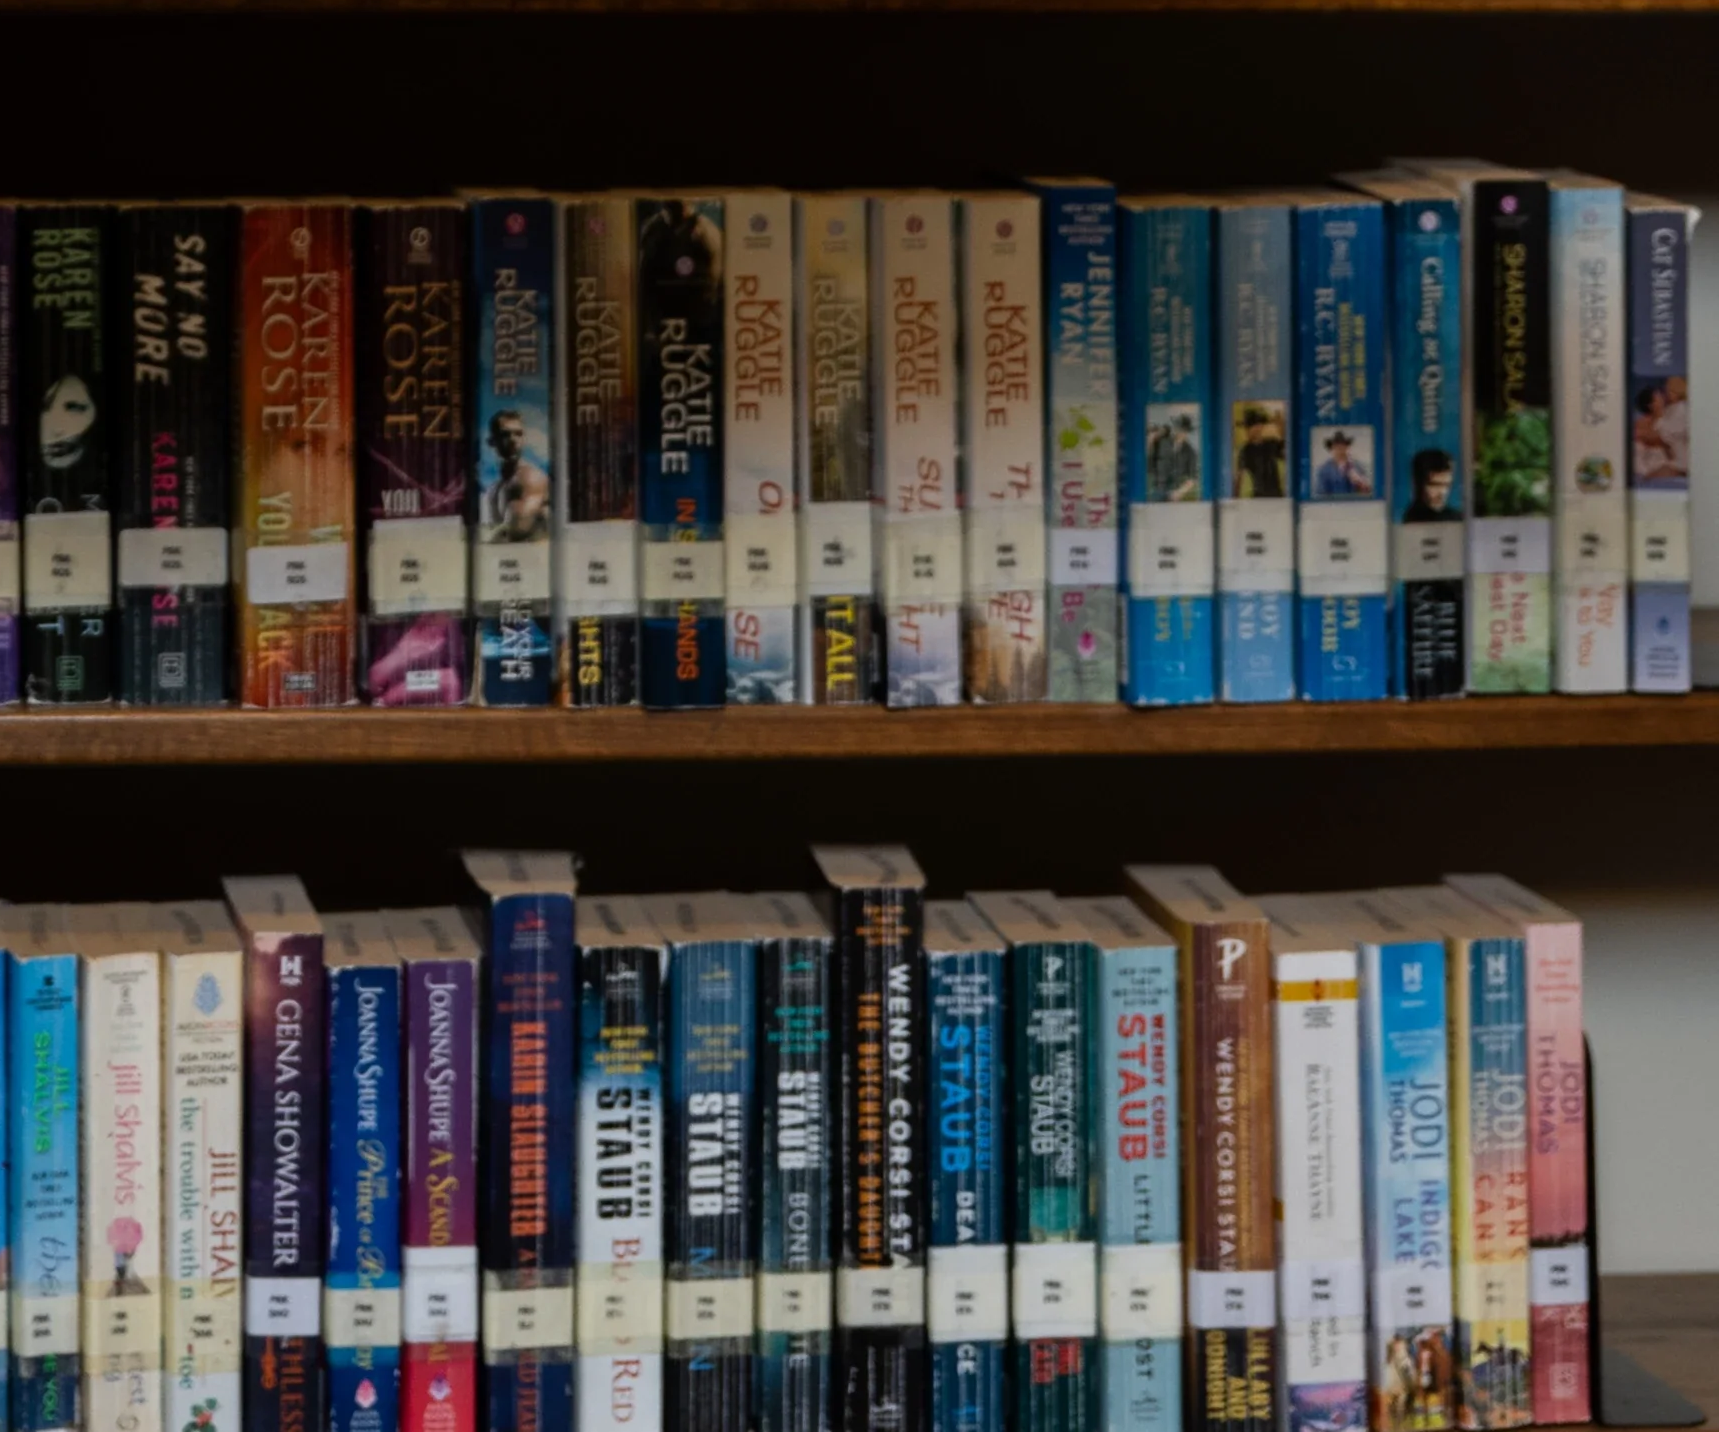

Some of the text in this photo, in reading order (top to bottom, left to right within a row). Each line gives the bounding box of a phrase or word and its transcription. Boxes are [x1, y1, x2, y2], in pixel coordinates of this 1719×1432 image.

[33, 229, 62, 309] ROSE
[64, 228, 92, 330] KAREN
[135, 274, 168, 385] MORE
[175, 236, 208, 359] SAY NO
[1059, 283, 1083, 365] RYAN
[1086, 252, 1112, 398] JENNIFER
[1504, 245, 1526, 414] SHARON SALA
[261, 275, 297, 431] ROSE
[301, 271, 329, 430] KAREN
[383, 286, 418, 439] ROSE
[419, 282, 450, 437] KAREN
[492, 269, 517, 395] RUGGLE
[516, 290, 538, 375] KATIE
[574, 276, 600, 426] RUGGLE
[599, 301, 623, 399] KATIE
[734, 275, 758, 422] RUGGLE
[757, 300, 782, 397] KATIE
[812, 276, 837, 427] RUGGLE
[837, 303, 862, 400] KATIE
[894, 277, 917, 425] RUGGLE
[915, 301, 938, 398] KATIE
[984, 282, 1007, 428] RUGGLE
[1005, 306, 1028, 403] KATIE
[1314, 346, 1336, 419] RYAN
[1587, 257, 1608, 425] SHARON SALA
[660, 318, 687, 474] RUGGLE
[684, 343, 713, 447] KATIE
[827, 639, 856, 689] ALL
[1484, 618, 1507, 662] Day
[34, 1031, 51, 1154] SHALVIS
[54, 1064, 69, 1116] JILL
[273, 999, 301, 1265] GENA SHOWALTER
[509, 1022, 545, 1235] KARIN SLAUGHTER
[777, 1071, 807, 1170] STAUB
[858, 993, 880, 1164] THE BUTCHER'S
[888, 965, 910, 1199] WENDY CORSI
[941, 1025, 971, 1172] STAUB
[977, 1025, 991, 1170] WENDY CORSI
[1031, 1076, 1054, 1154] STAUB
[1056, 1050, 1075, 1176] WENDY CORSI
[1118, 1015, 1147, 1161] STAUB
[1152, 1015, 1166, 1159] WENDY CORSI
[1215, 1039, 1232, 1206] WENDY CORSI
[1390, 1081, 1406, 1163] THOMAS
[1411, 1080, 1443, 1161] JODI
[1473, 1071, 1491, 1154] THOMAS
[1493, 1069, 1523, 1152] JODI
[1536, 1036, 1557, 1154] THOMAS
[1561, 1061, 1581, 1124] JODI
[180, 1098, 197, 1271] the trouble with
[208, 1147, 237, 1196] JILL
[597, 1089, 632, 1218] STAUB
[635, 1088, 652, 1217] WENDY CORSI
[688, 1093, 723, 1217] STAUB
[725, 1094, 739, 1215] WENDY CORSI
[1394, 1198, 1414, 1264] LAKE
[611, 1359, 640, 1422] RED
[1228, 1376, 1247, 1421] AND
